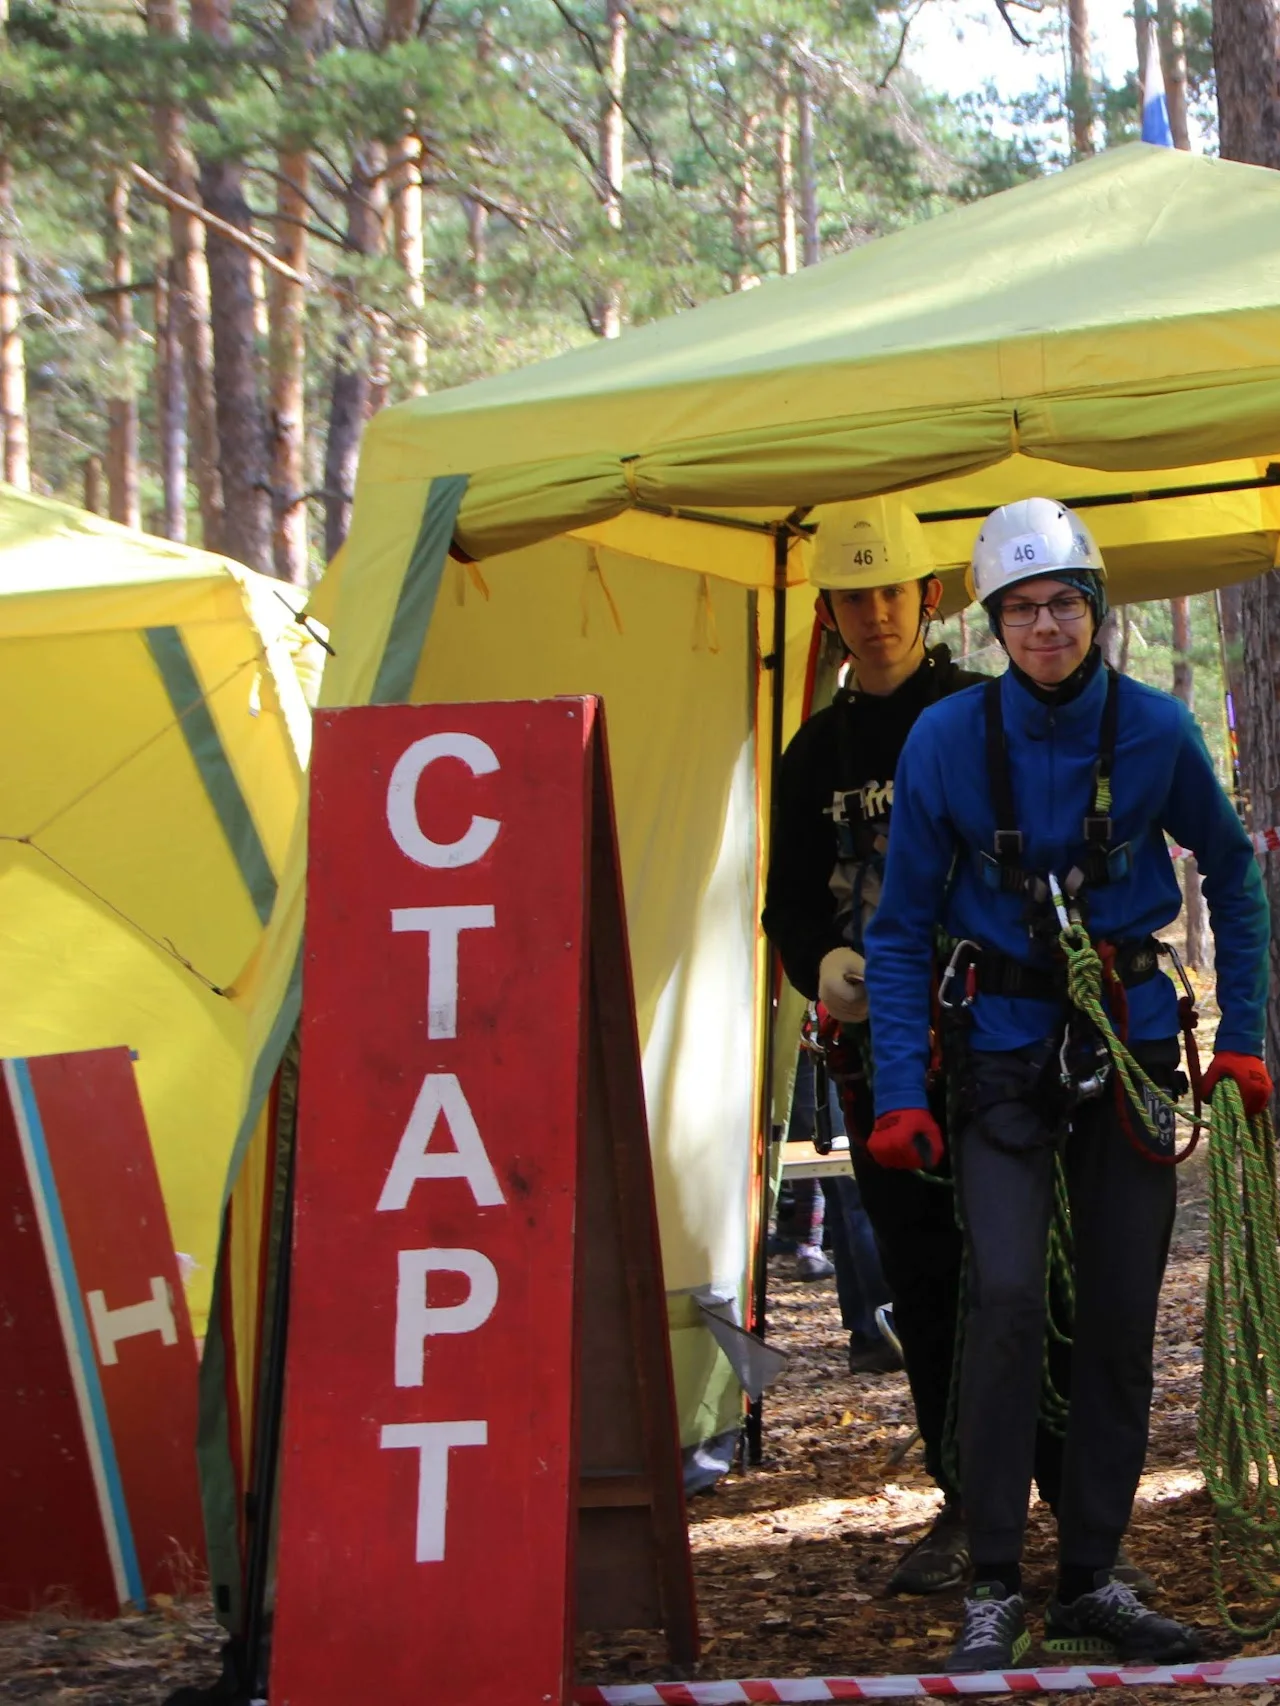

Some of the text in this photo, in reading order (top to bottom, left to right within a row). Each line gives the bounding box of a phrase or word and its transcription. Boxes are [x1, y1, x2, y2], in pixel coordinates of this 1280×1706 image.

[853, 550, 873, 565] 46
[1014, 544, 1035, 562] 46
[376, 732, 505, 1562] СТАРТ
